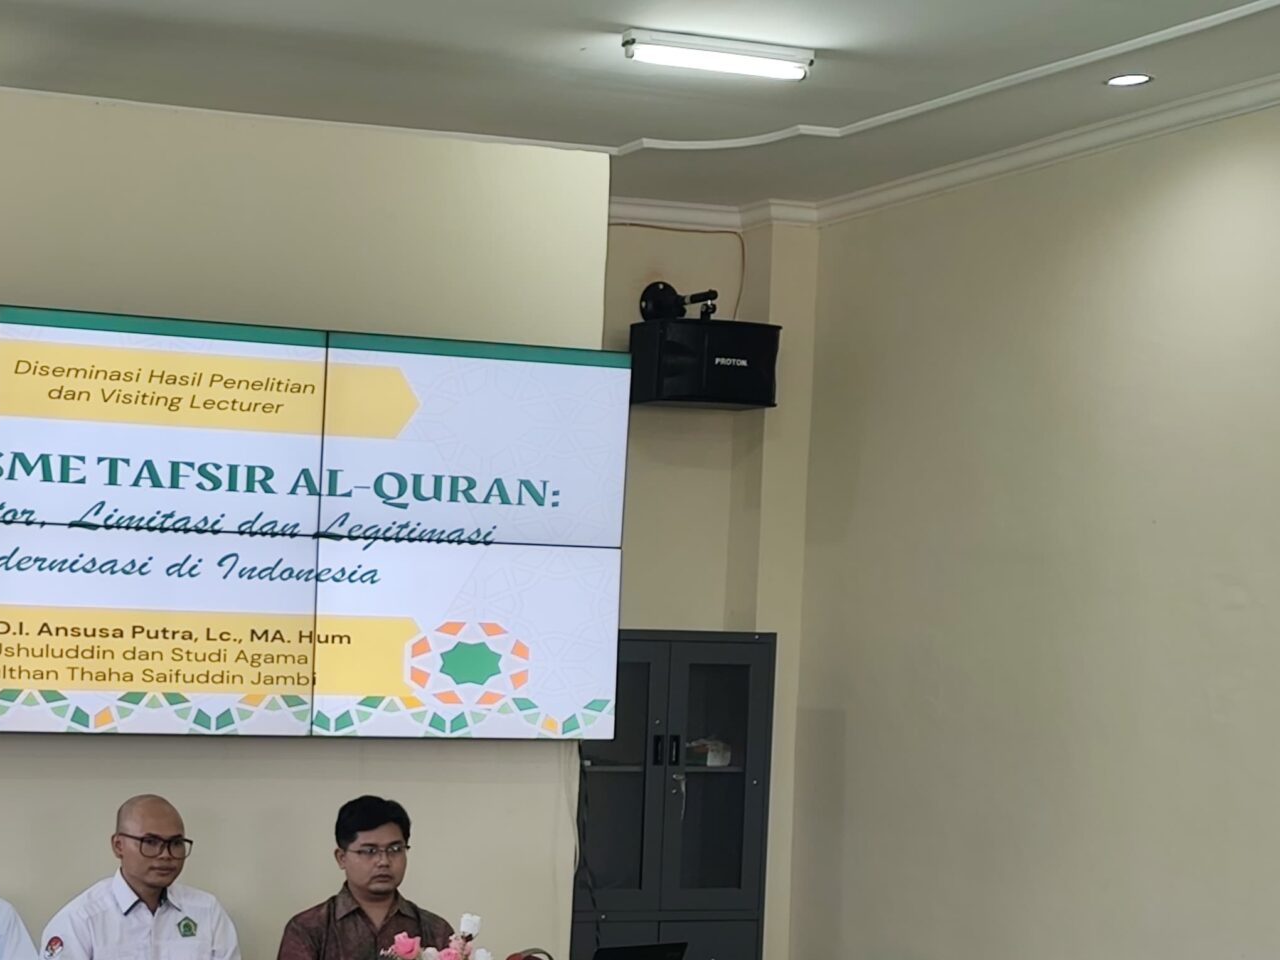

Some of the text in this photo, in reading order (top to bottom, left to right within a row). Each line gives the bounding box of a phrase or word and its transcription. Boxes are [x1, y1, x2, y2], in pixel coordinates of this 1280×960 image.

[13, 359, 316, 395] Diseminasi Hasil Penelitian
[48, 385, 285, 415] dan Visiting Lecturer
[97, 456, 276, 495] TAFSIR
[288, 467, 561, 510] AL-QURAN:
[69, 500, 226, 536] Limitasi
[237, 511, 302, 539] dan
[312, 512, 497, 551] Legitimasi
[165, 554, 203, 579] di
[217, 552, 381, 585] Indonesia
[37, 622, 124, 639] Ansusa
[131, 625, 199, 643] Putra,
[206, 628, 243, 644] Lc.,
[250, 629, 291, 644] MA.
[298, 630, 351, 645] Hum
[122, 646, 163, 662] dan
[171, 647, 228, 663] Studi
[234, 649, 308, 668] Agama
[67, 666, 134, 683] Thaha
[141, 668, 244, 685] Saifuddin
[250, 671, 317, 687] Jambi
